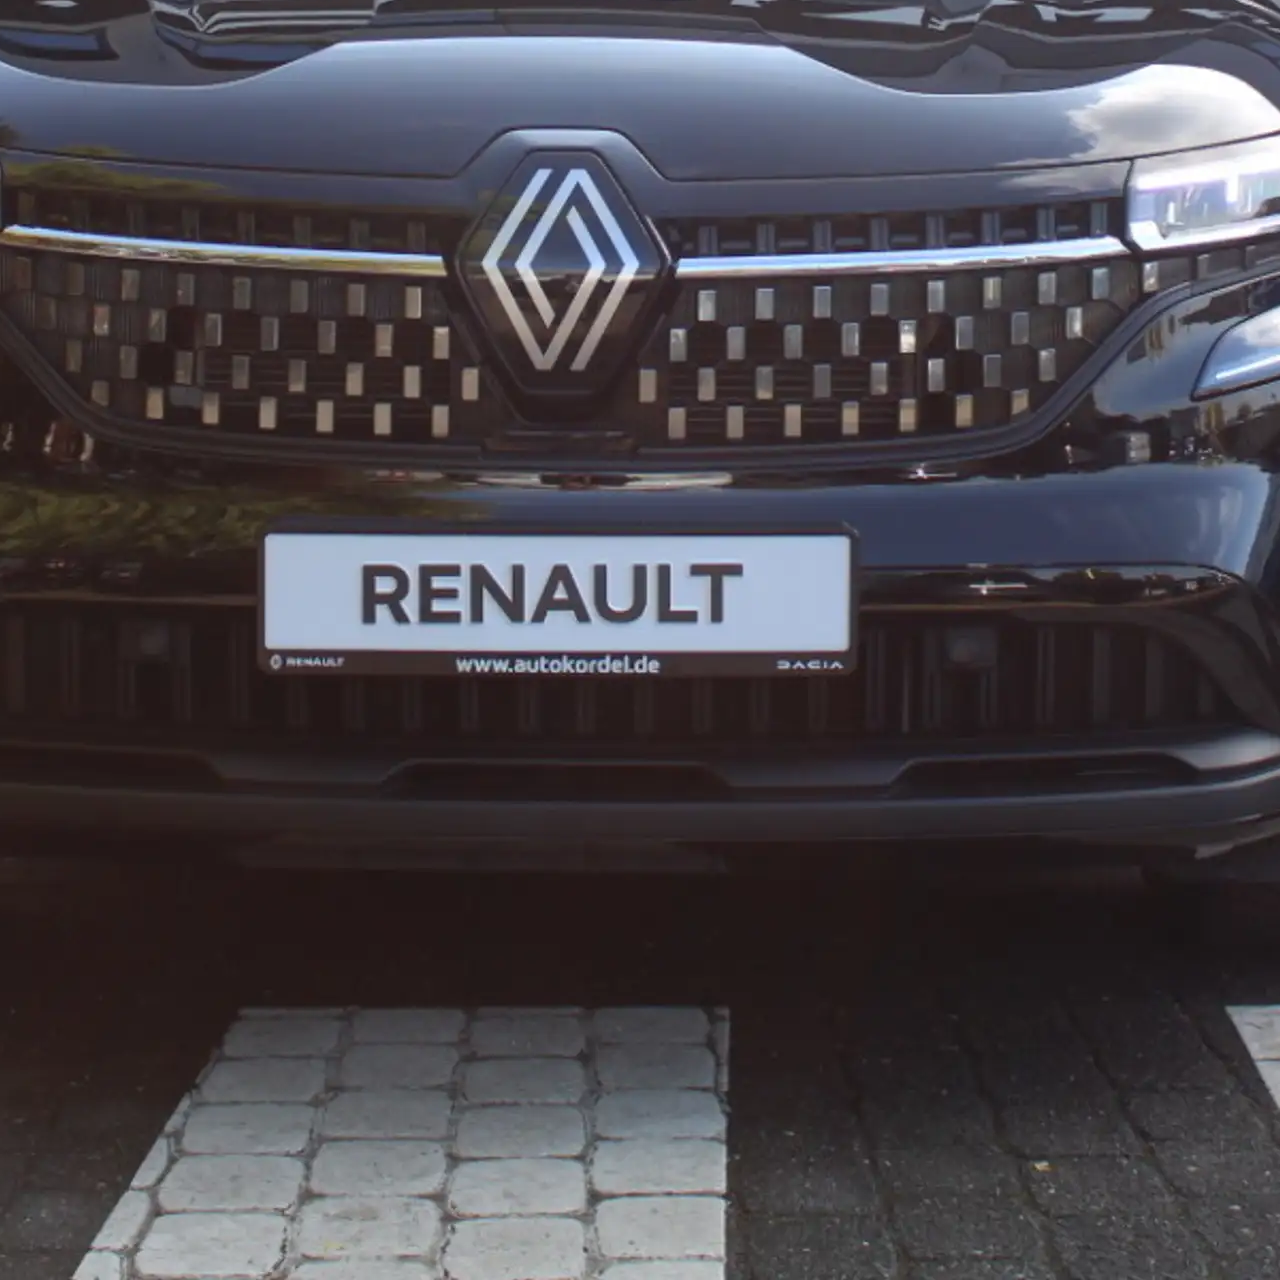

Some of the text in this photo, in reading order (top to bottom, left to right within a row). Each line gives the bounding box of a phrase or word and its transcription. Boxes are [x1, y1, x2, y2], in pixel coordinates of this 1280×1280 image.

[361, 563, 744, 625] RENAULT
[285, 656, 345, 668] RENAULT
[456, 655, 660, 674] www.autokordel.de
[776, 659, 845, 670] DACIA
